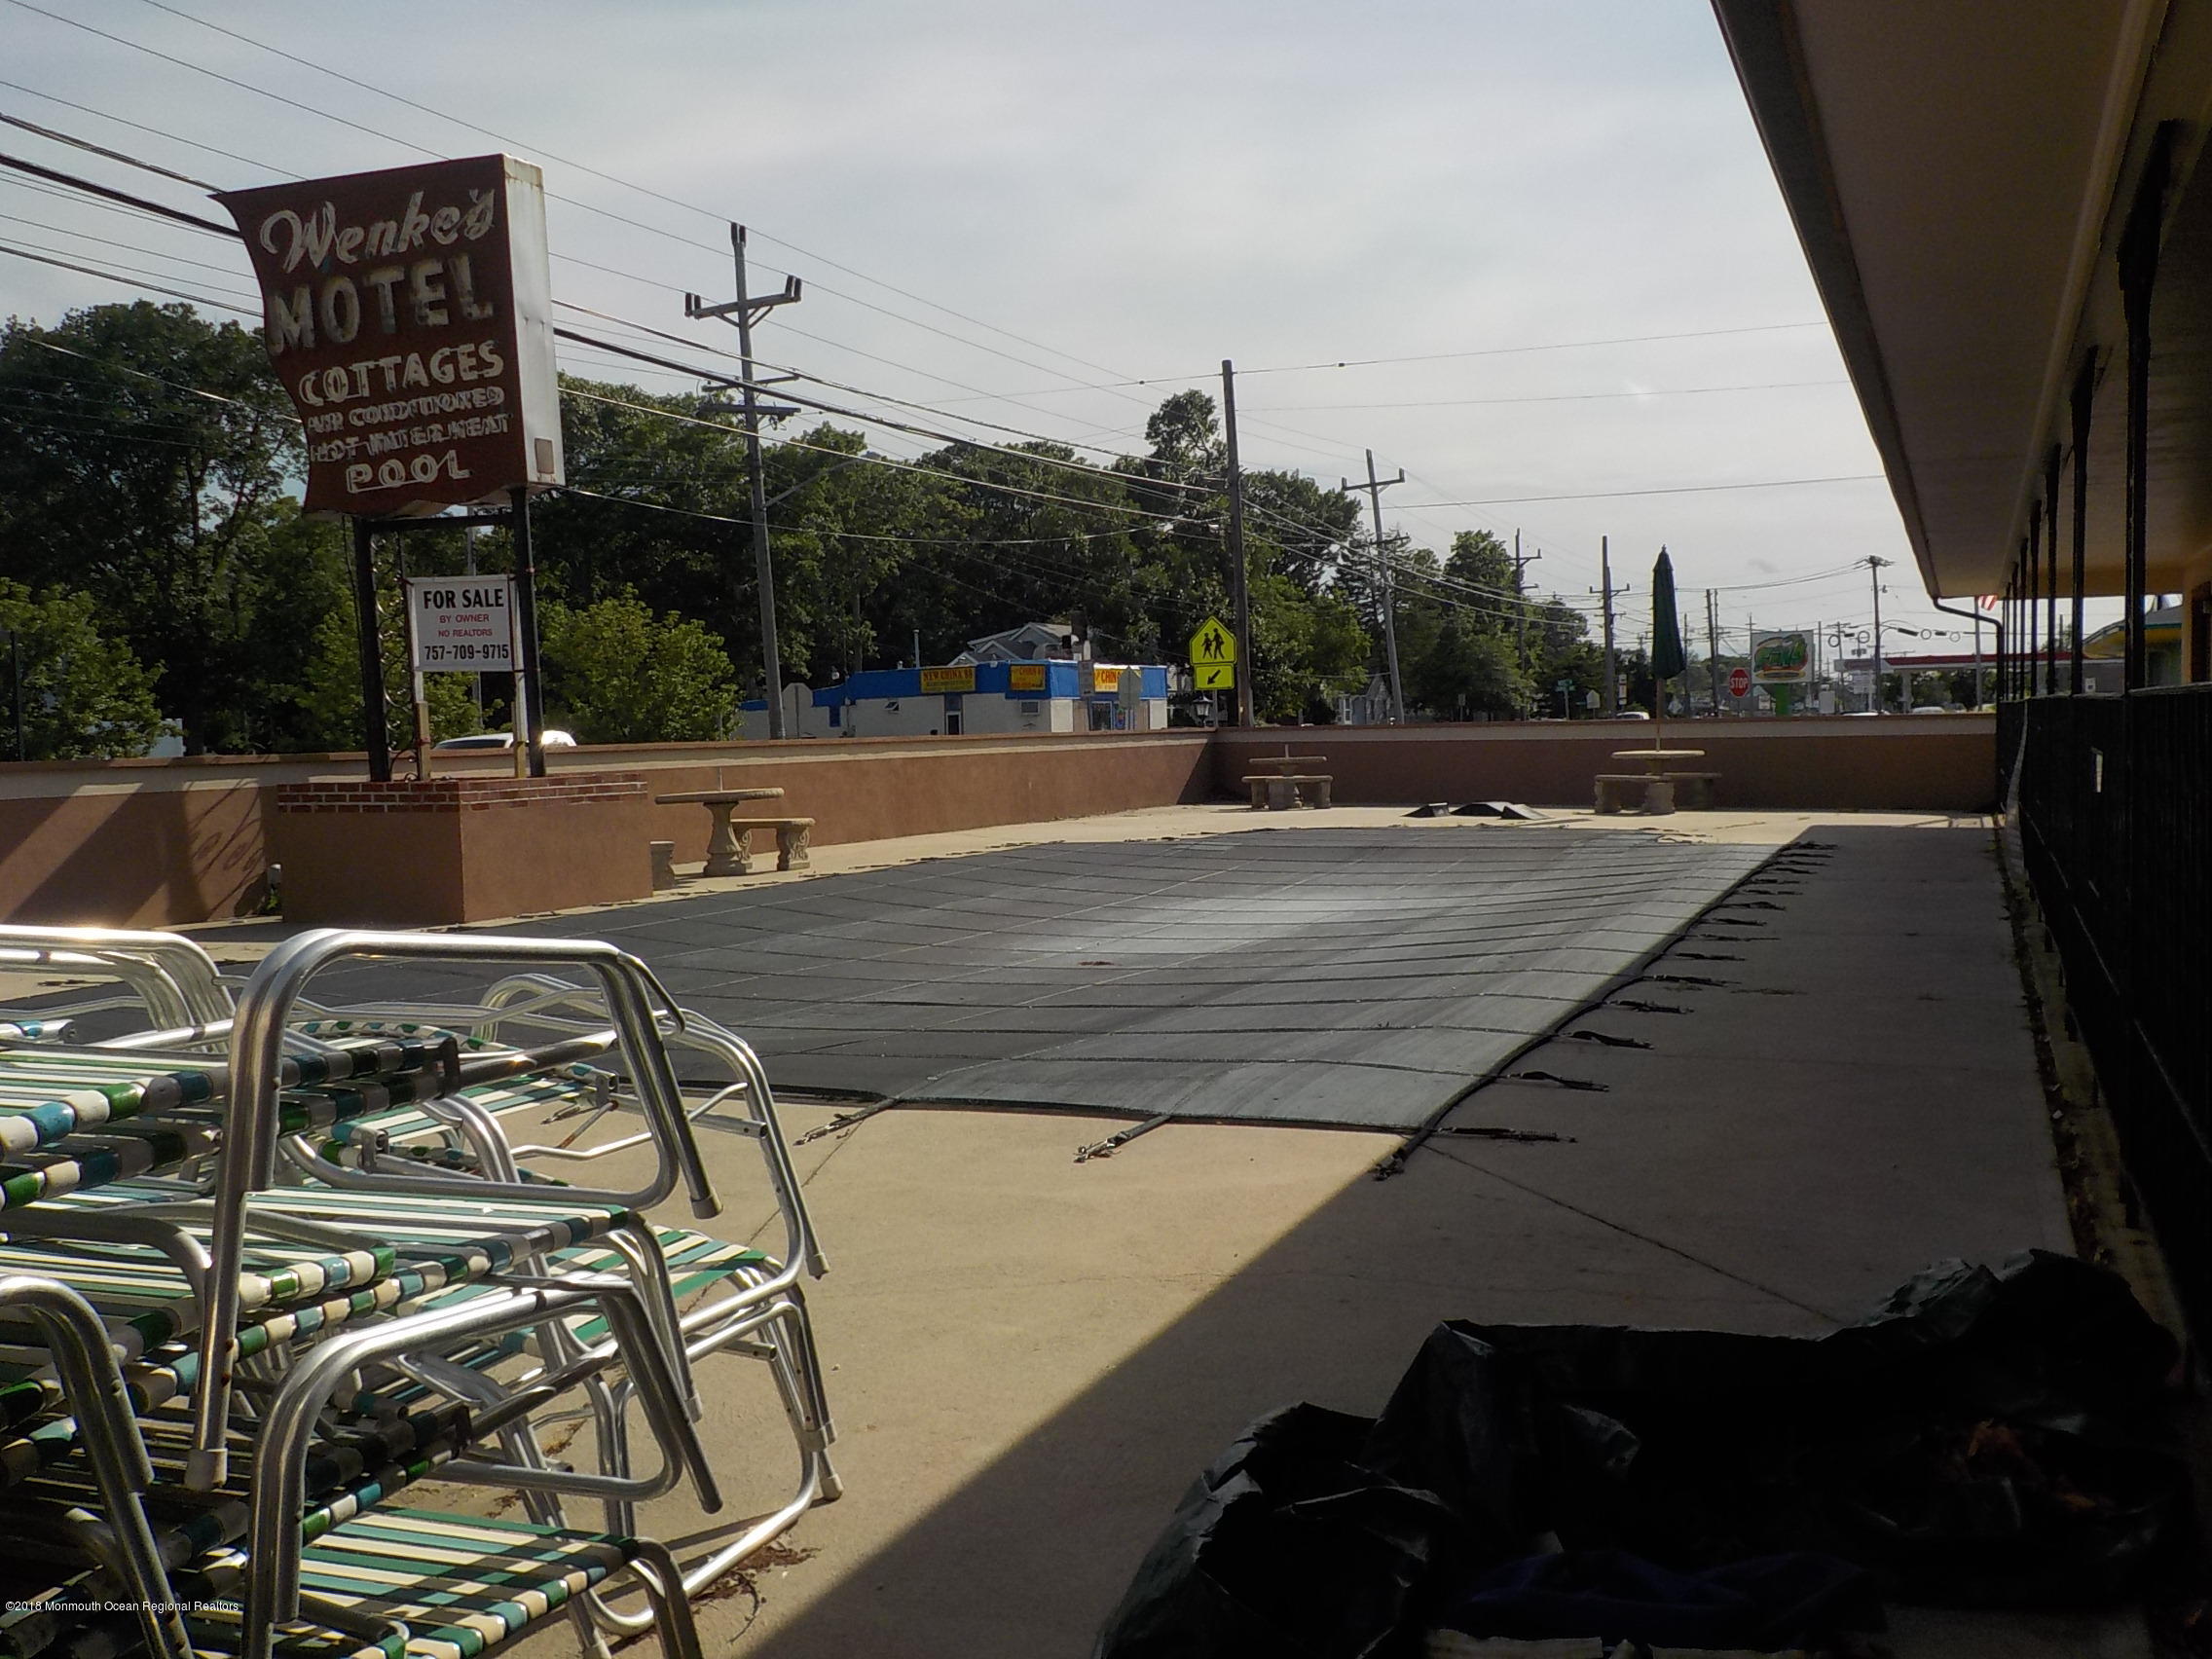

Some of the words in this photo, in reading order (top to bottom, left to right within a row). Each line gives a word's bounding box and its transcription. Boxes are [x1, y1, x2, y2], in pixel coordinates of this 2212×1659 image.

[267, 252, 494, 356] MOTEL
[299, 339, 504, 406] COTTAGES
[307, 412, 344, 433] AIR
[349, 386, 505, 426] CONDITIONED
[310, 436, 360, 462] HOT
[346, 449, 471, 494] POOL
[423, 590, 457, 609] FOR
[461, 588, 504, 608] SALE
[439, 614, 452, 624] BY
[455, 613, 490, 623] OWNER
[438, 629, 450, 638] NO
[452, 628, 494, 638] REALTORS
[424, 644, 509, 661] 757-709-9715
[940, 669, 962, 680] CHINA
[1729, 677, 1749, 689] STOP
